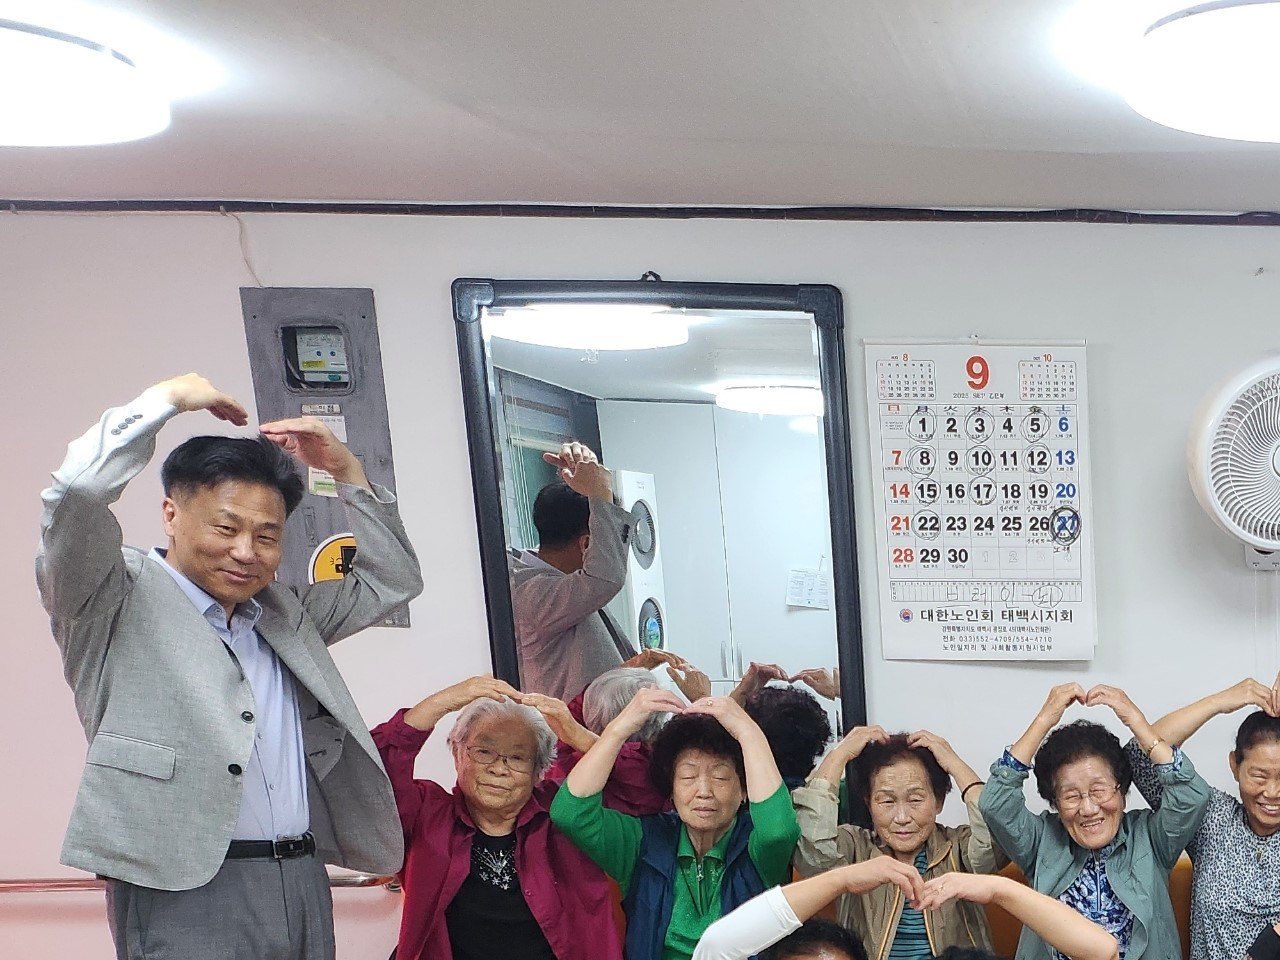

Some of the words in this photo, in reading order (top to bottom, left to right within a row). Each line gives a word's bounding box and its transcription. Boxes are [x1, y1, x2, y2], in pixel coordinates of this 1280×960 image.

[902, 354, 909, 362] 8
[1043, 354, 1052, 362] 10
[966, 355, 990, 391] 9
[918, 417, 927, 433] 1
[946, 417, 958, 433] 2
[974, 417, 985, 433] 3
[1002, 417, 1013, 433] 4
[1030, 417, 1041, 433] 5
[1058, 417, 1069, 433] 6
[892, 451, 902, 466] 7
[919, 451, 930, 466] 8
[948, 451, 959, 466] 9
[972, 451, 992, 466] 10
[1000, 451, 1018, 466] 11
[1027, 451, 1047, 466] 12
[1056, 451, 1075, 466] 13
[890, 483, 910, 499] 14
[917, 483, 937, 499] 15
[946, 483, 965, 499] 16
[973, 483, 993, 499] 17
[1002, 483, 1021, 499] 18
[1029, 483, 1048, 499] 19
[1055, 483, 1076, 499] 20
[890, 516, 910, 531] 21
[918, 516, 940, 531] 22
[946, 516, 967, 531] 23
[973, 516, 995, 531] 24
[1002, 516, 1022, 531] 25
[1029, 516, 1050, 531] 26
[893, 548, 914, 563] 28
[920, 548, 941, 563] 29
[948, 548, 969, 563] 30
[920, 609, 994, 623] 대한노인회
[1001, 609, 1073, 623] 태백시지회
[991, 644, 1053, 652] 사회활동지원사업부
